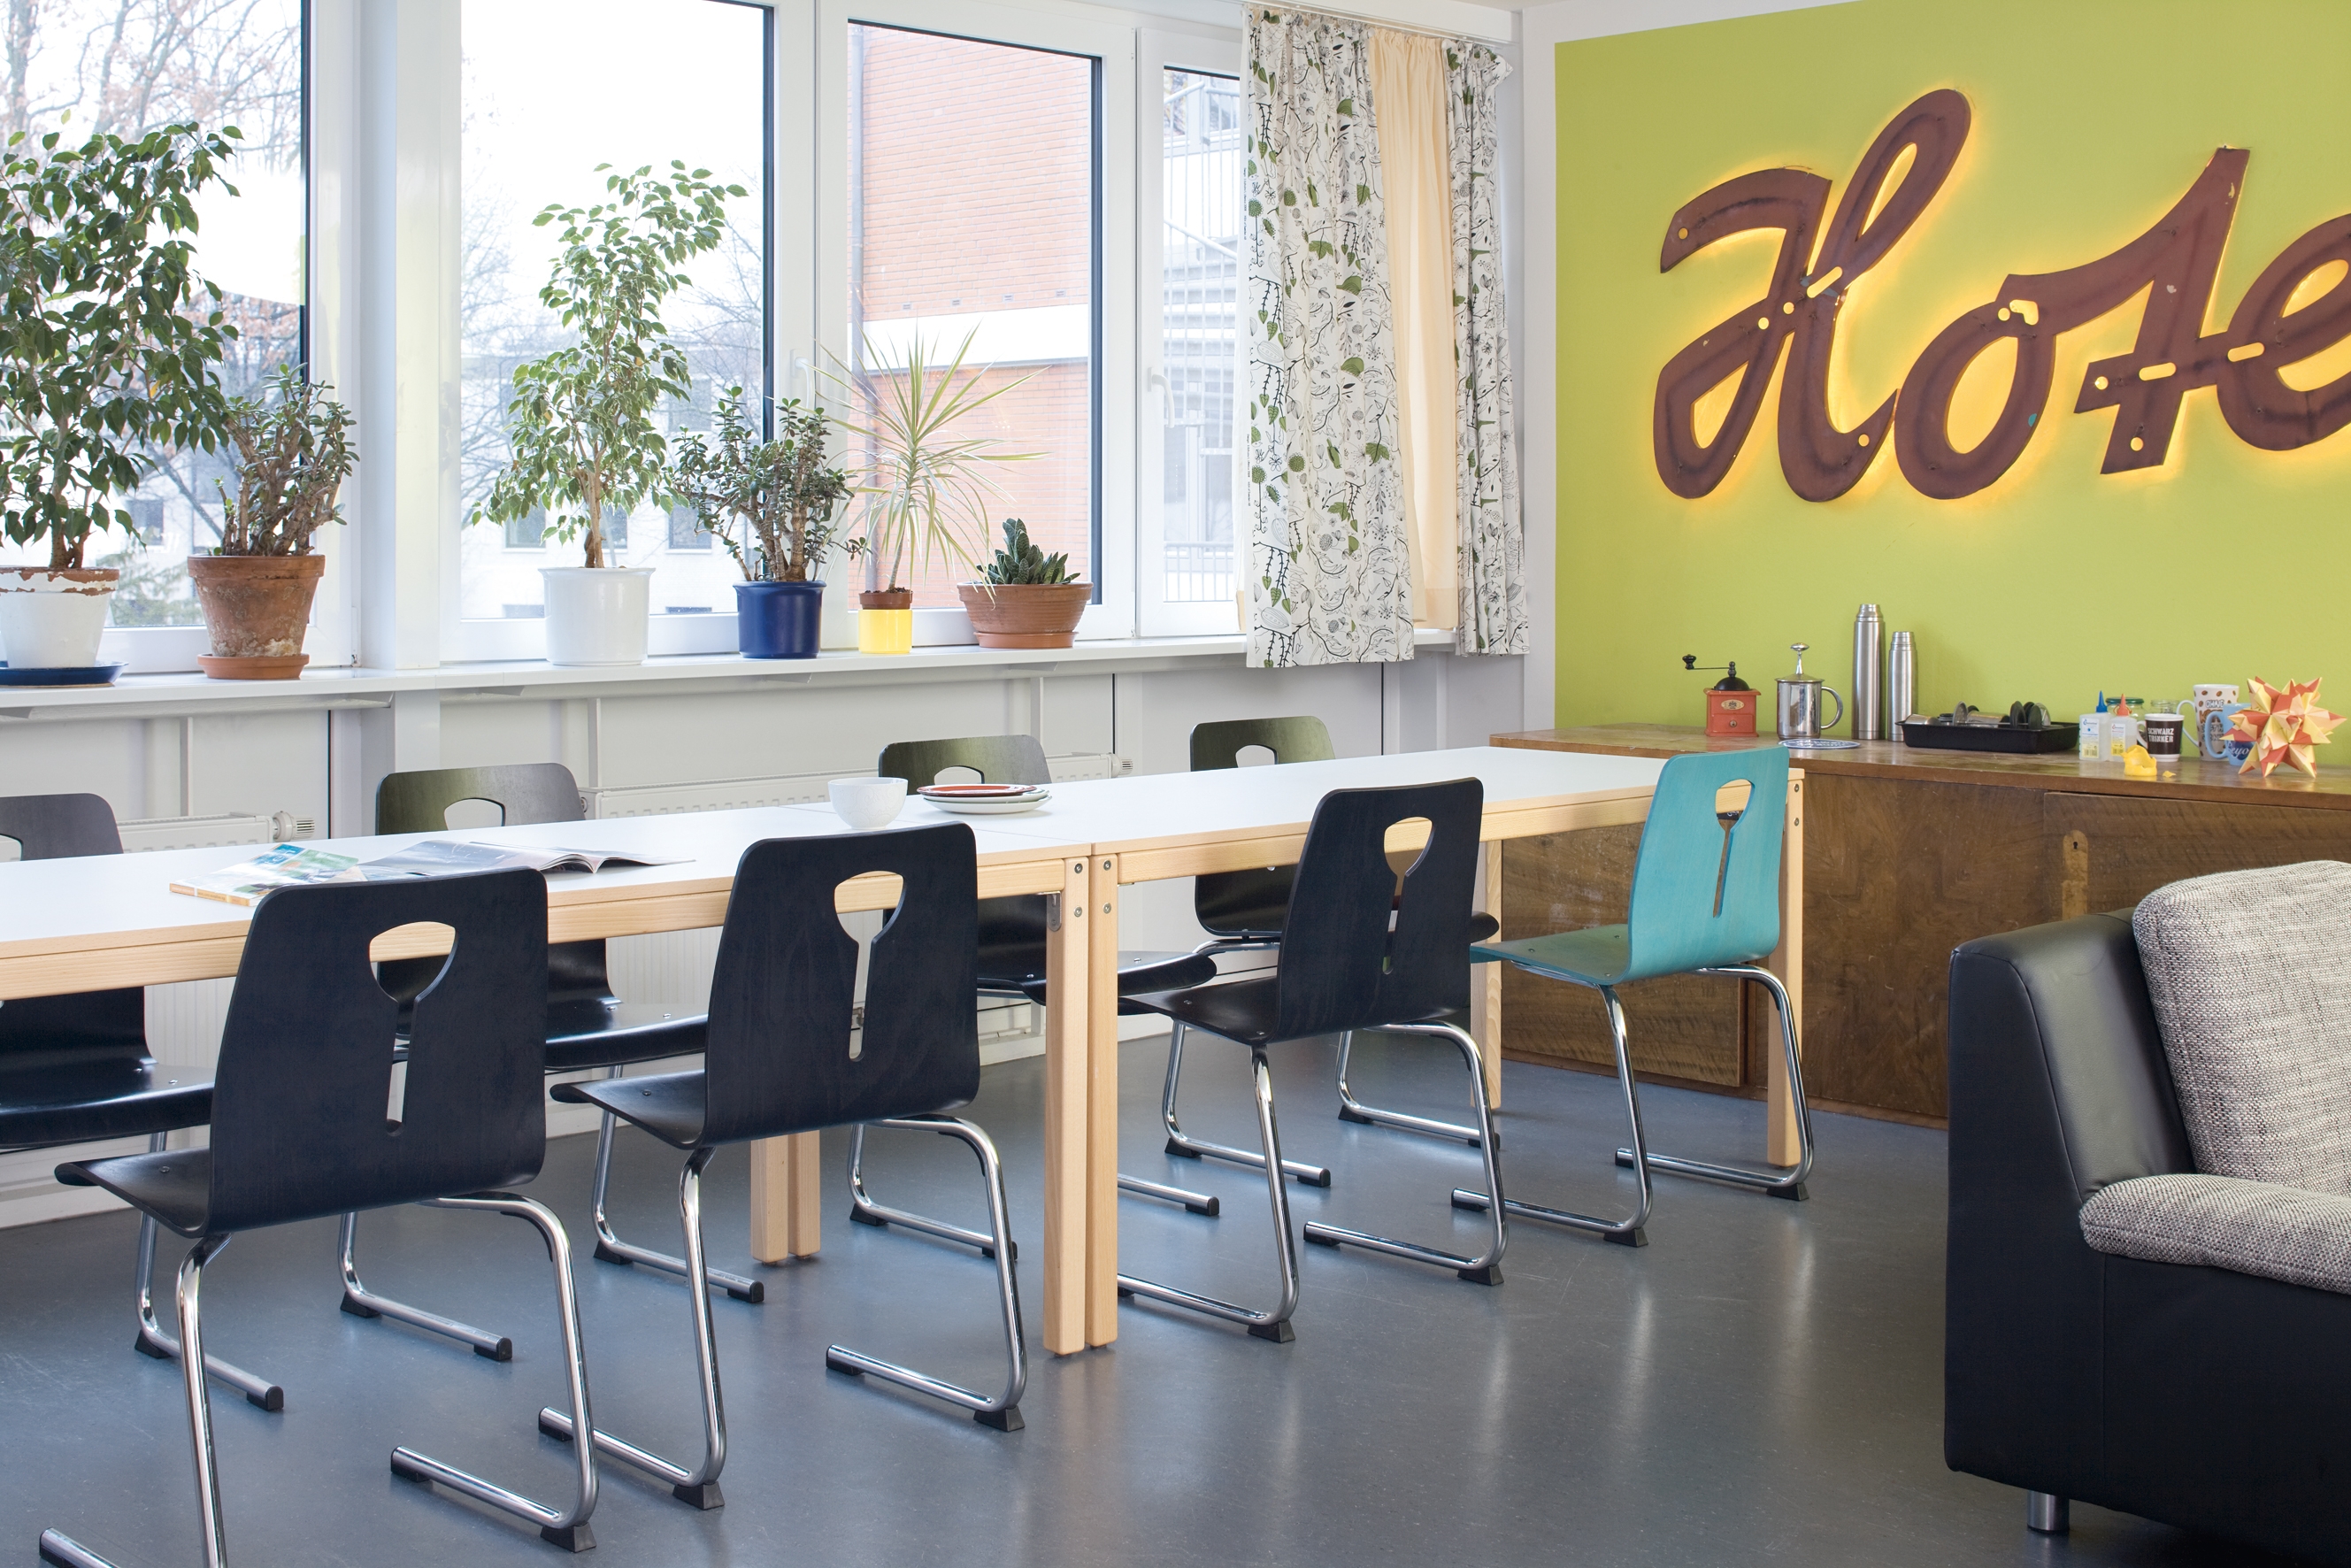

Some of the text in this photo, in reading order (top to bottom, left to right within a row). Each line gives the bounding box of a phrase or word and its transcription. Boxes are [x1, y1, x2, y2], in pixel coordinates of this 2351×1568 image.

[1653, 88, 2351, 503] Hote
[2205, 699, 2224, 708] OHNE
[2148, 734, 2174, 743] TRINKER
